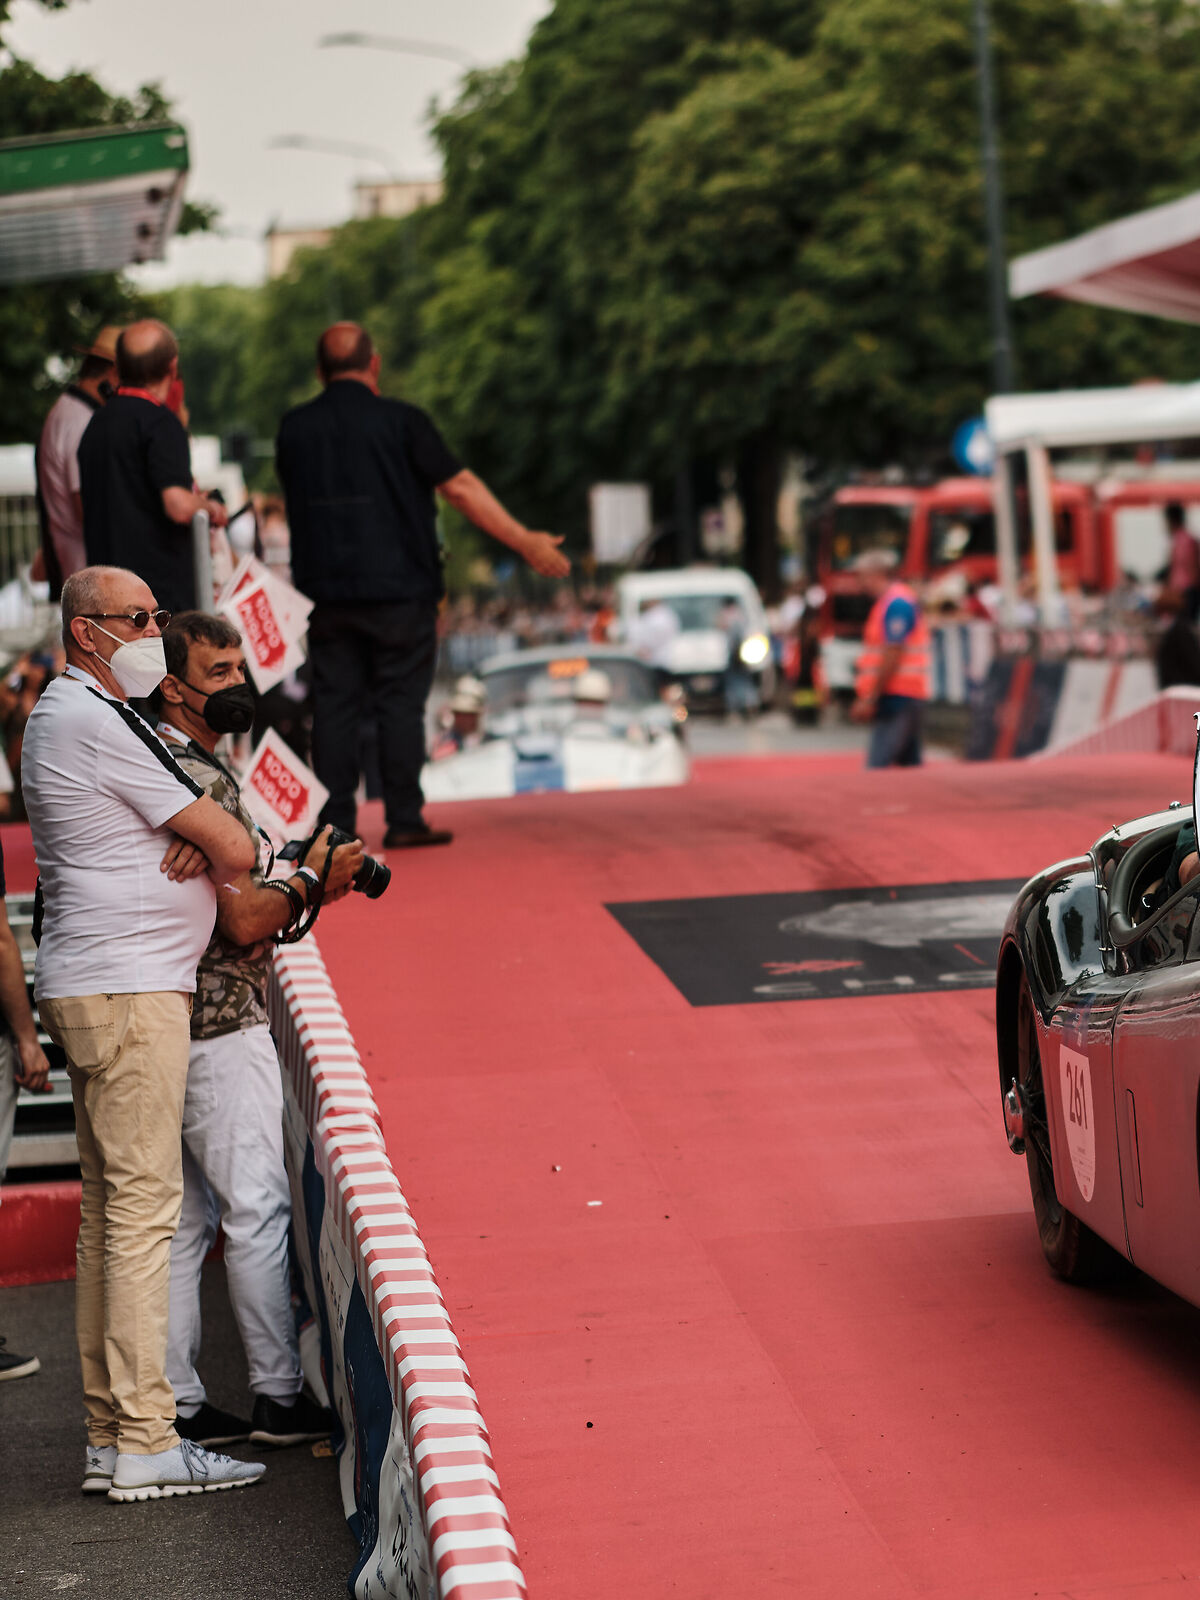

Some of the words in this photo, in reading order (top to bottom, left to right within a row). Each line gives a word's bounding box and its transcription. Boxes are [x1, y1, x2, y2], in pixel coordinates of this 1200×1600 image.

[255, 594, 280, 649] 1000
[265, 754, 301, 799] 1000
[1066, 1061, 1088, 1130] 261
